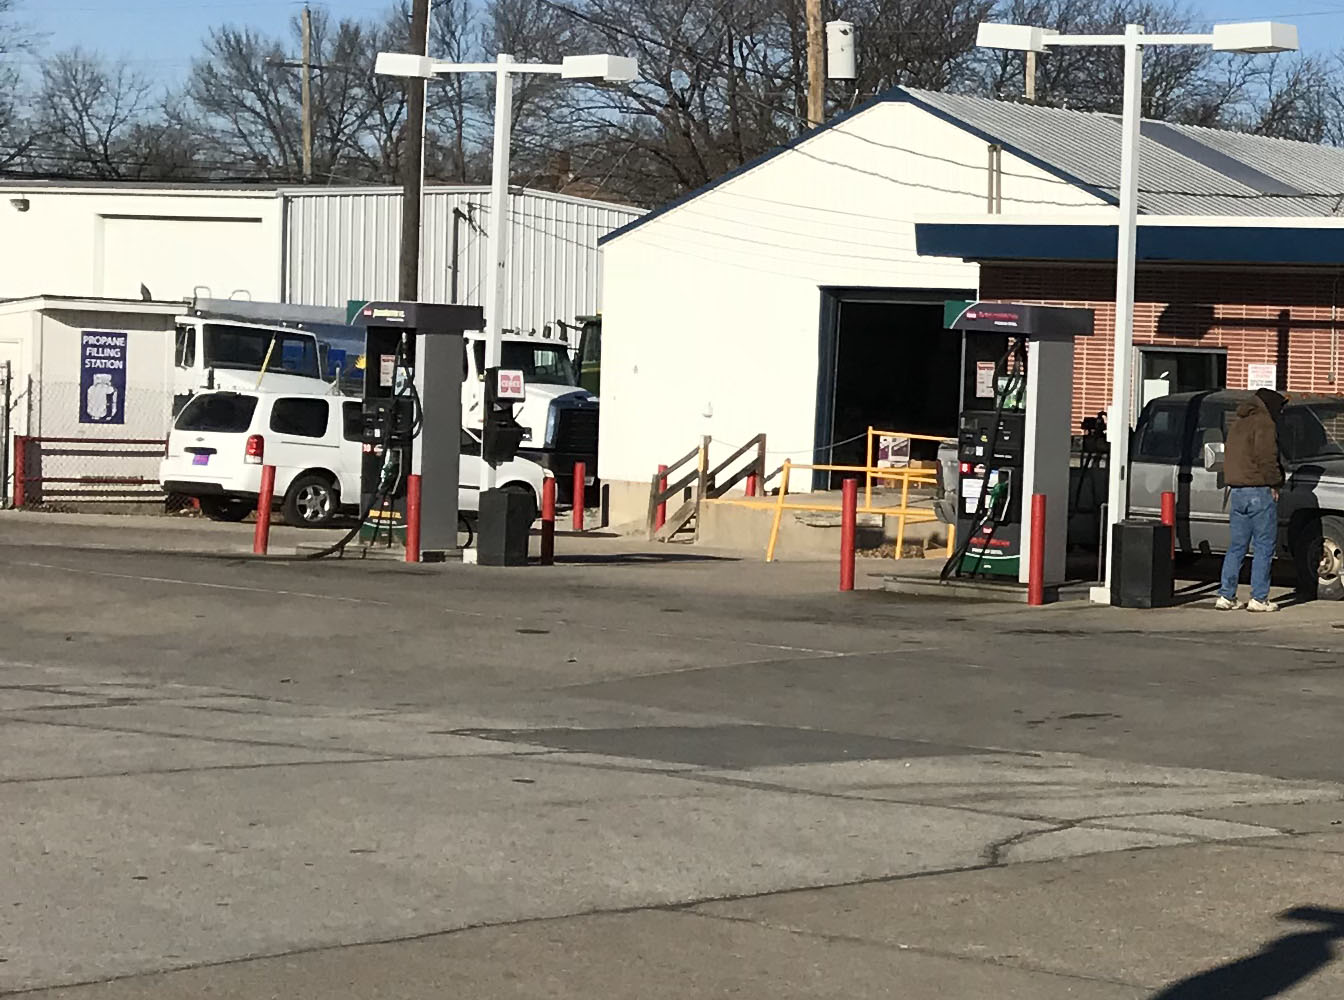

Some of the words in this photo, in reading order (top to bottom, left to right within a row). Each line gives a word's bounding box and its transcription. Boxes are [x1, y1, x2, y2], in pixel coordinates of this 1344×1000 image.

[83, 335, 126, 346] PROPANE
[86, 346, 121, 357] FILLING
[85, 358, 123, 369] STATION
